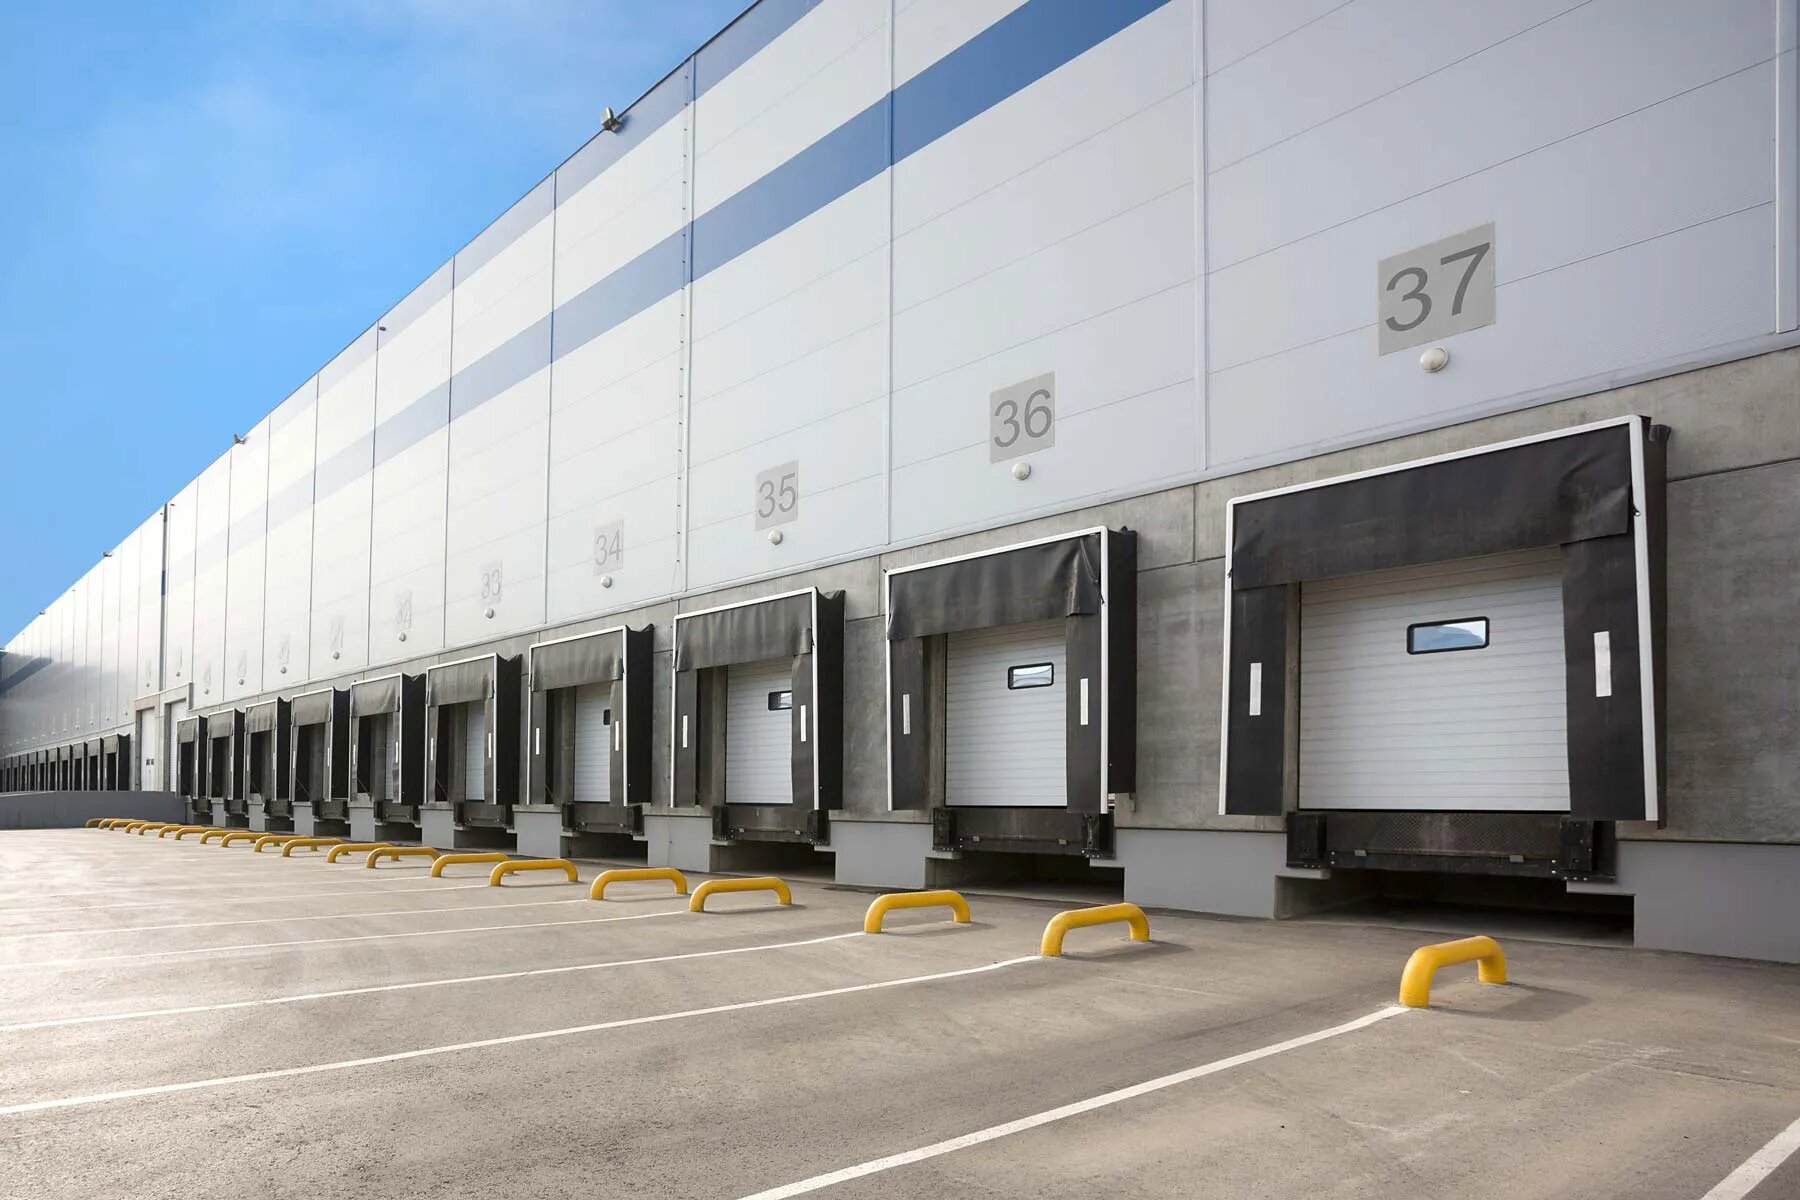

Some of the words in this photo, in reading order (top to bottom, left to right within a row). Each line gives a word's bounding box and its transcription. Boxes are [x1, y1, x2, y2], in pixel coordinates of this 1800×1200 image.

[1385, 242, 1491, 332] 37
[993, 388, 1053, 448] 36
[758, 472, 798, 518] 35
[595, 529, 622, 566] 34
[481, 569, 501, 599] 33
